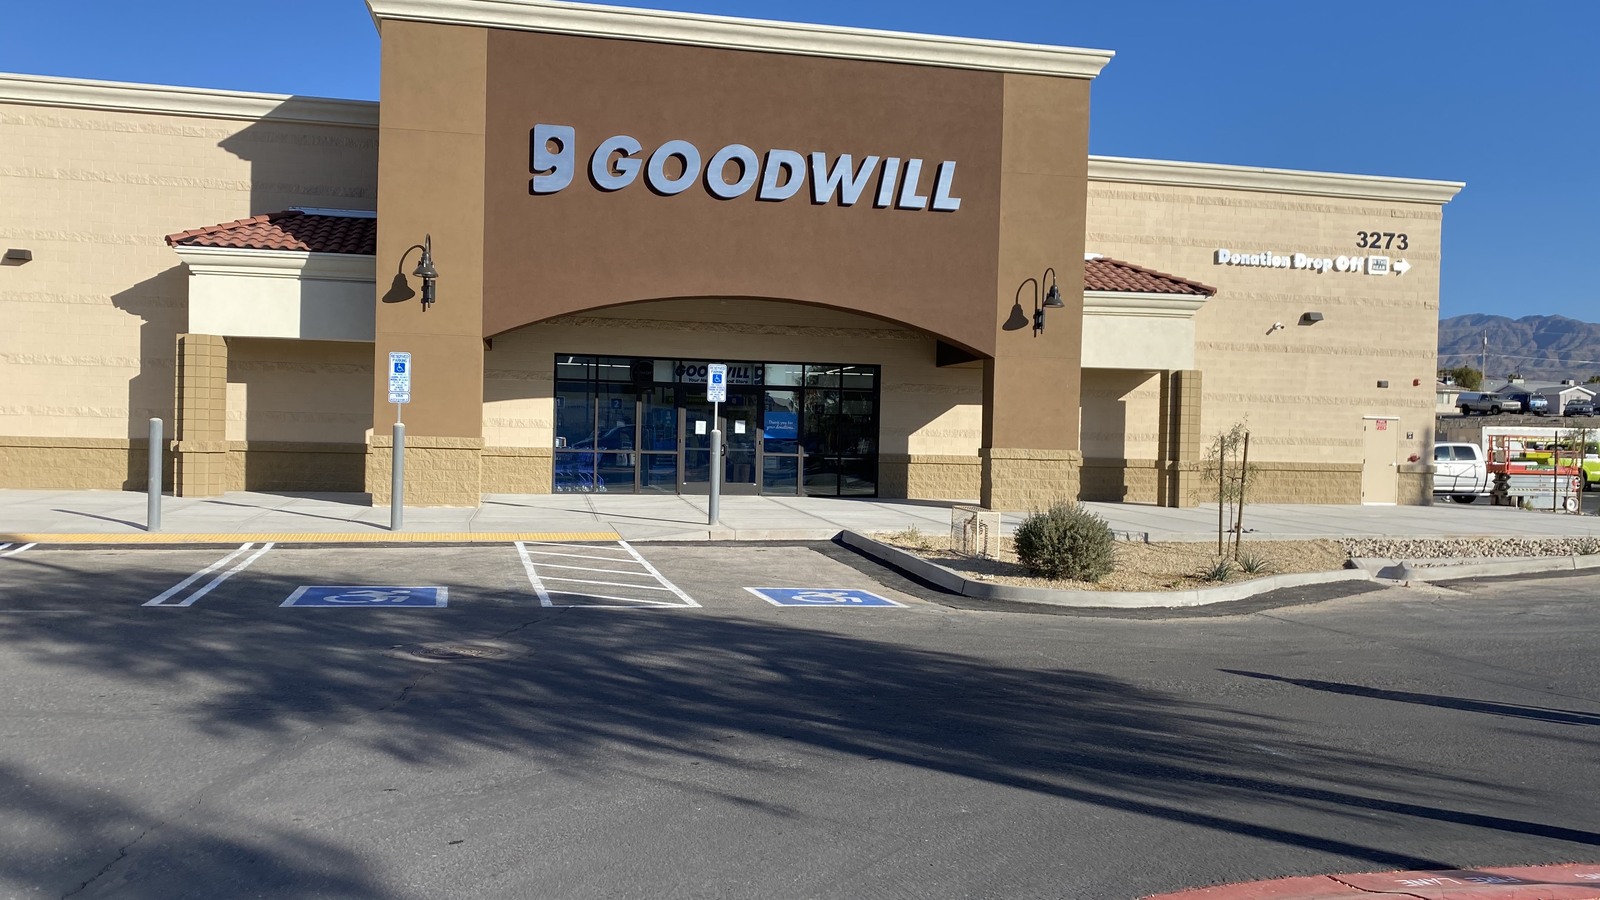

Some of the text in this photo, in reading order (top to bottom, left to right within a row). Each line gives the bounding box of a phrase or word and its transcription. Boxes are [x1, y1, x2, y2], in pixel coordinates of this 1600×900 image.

[589, 135, 962, 210] GOODWILL
[1356, 231, 1409, 250] 3273
[1217, 249, 1365, 273] Donation Drop Off
[1395, 877, 1462, 887] LANE
